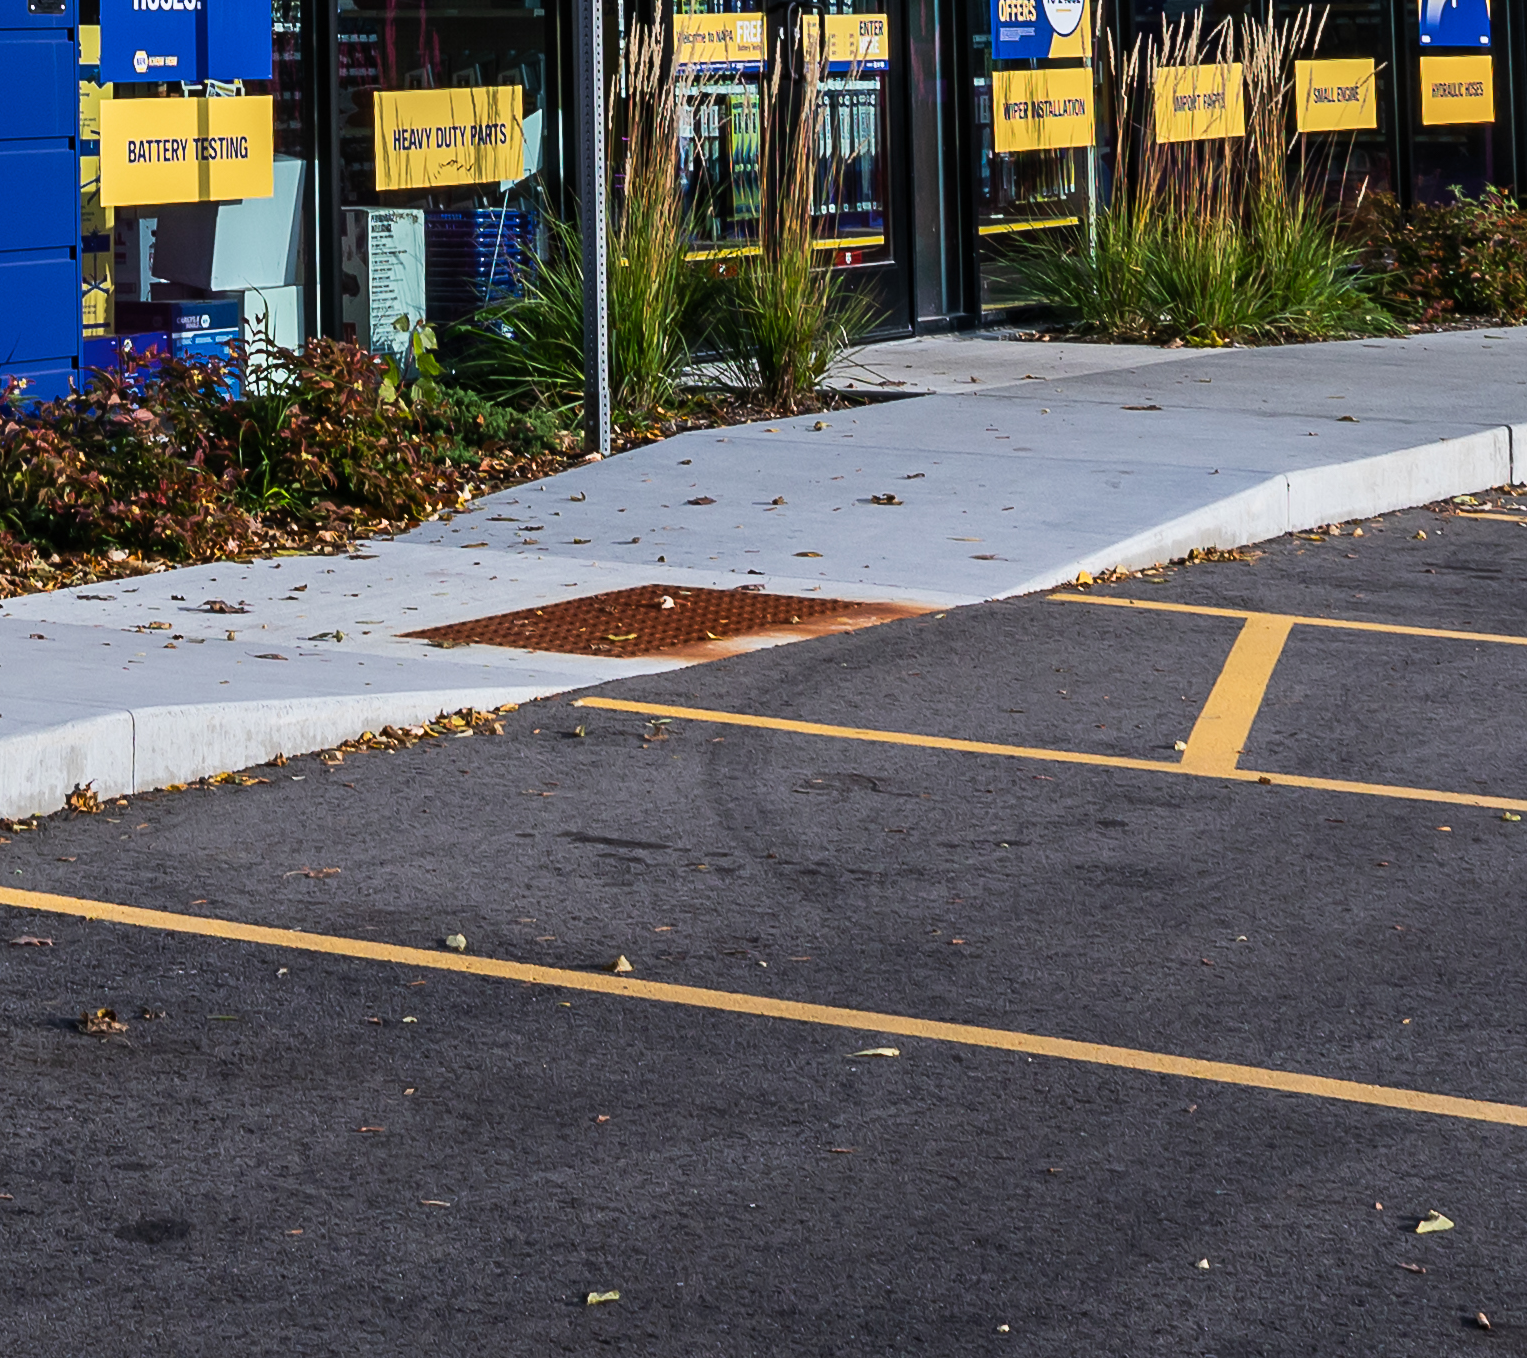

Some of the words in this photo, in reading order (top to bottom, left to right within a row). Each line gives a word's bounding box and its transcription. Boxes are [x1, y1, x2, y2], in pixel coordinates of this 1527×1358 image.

[998, 0, 1037, 22] OFFERS
[708, 31, 715, 43] to
[716, 29, 734, 43] NAPA
[859, 20, 884, 37] ENTER
[859, 36, 880, 55] HERE
[1313, 86, 1335, 103] SMALL
[1337, 85, 1360, 103] ENGINE
[1432, 82, 1463, 98] HYDRAULIC
[1465, 81, 1484, 97] HOSES
[1003, 101, 1028, 121] WIPER
[1031, 98, 1085, 119] INSTALLATION
[1174, 94, 1201, 113] IMPORT
[393, 127, 432, 152] HEAVY
[436, 125, 466, 149] DUTY
[470, 123, 507, 146] PARTS
[127, 138, 188, 164] BATTERY
[193, 136, 248, 161] TESTING
